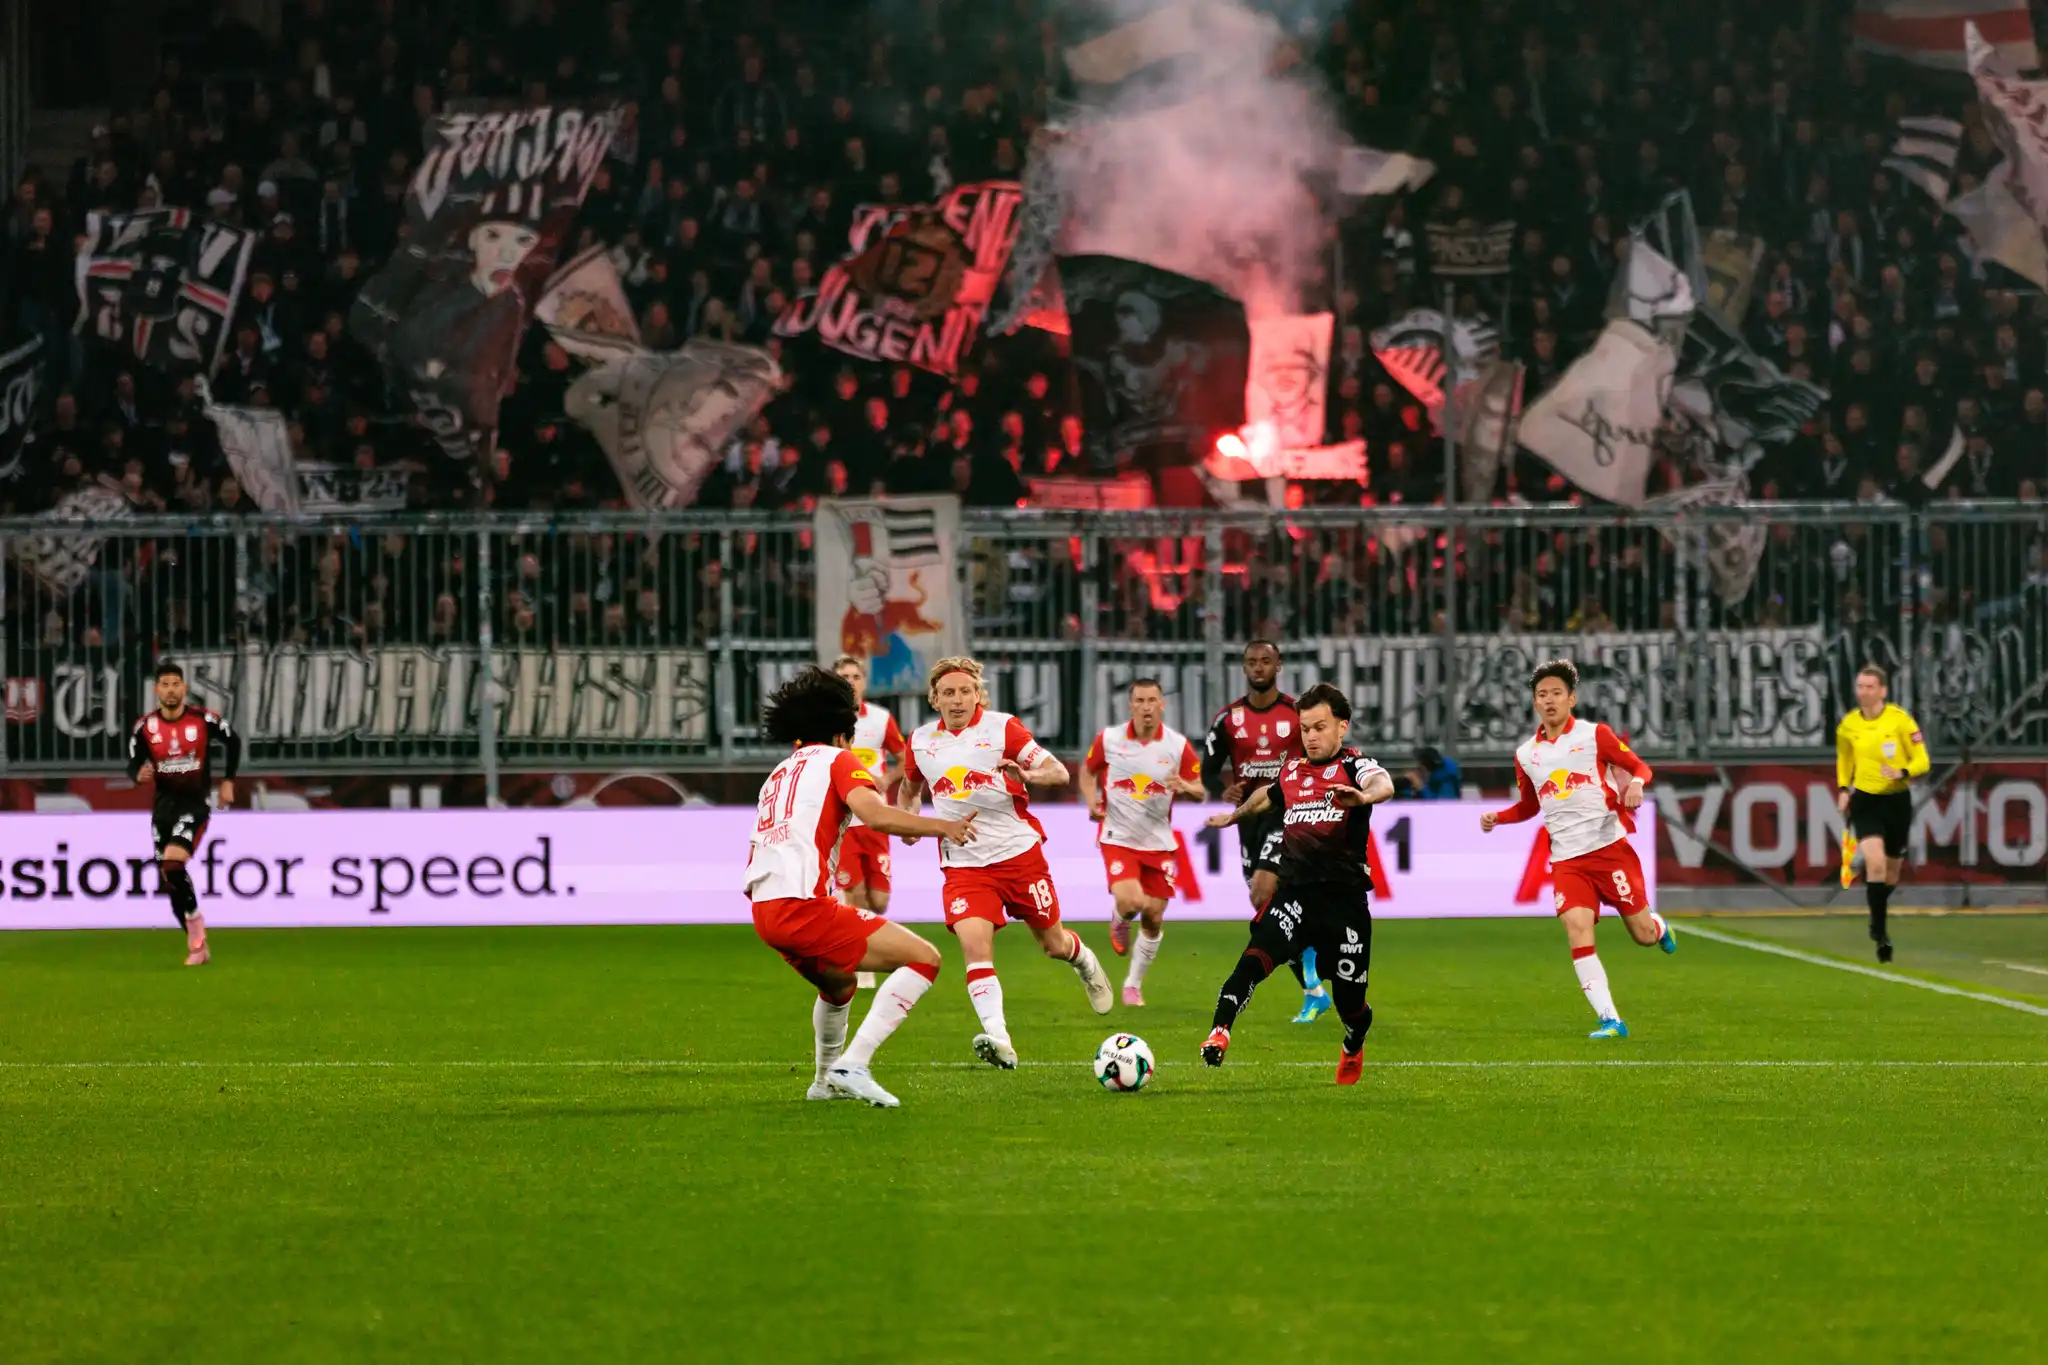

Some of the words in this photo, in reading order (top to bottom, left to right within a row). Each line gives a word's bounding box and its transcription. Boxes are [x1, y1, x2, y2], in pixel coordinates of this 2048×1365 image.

[0, 842, 168, 898] sion
[202, 838, 303, 898] for
[331, 836, 577, 912] speed.
[1611, 869, 1631, 897] 8
[1028, 879, 1054, 911] 18
[1270, 907, 1294, 930] HYPO
